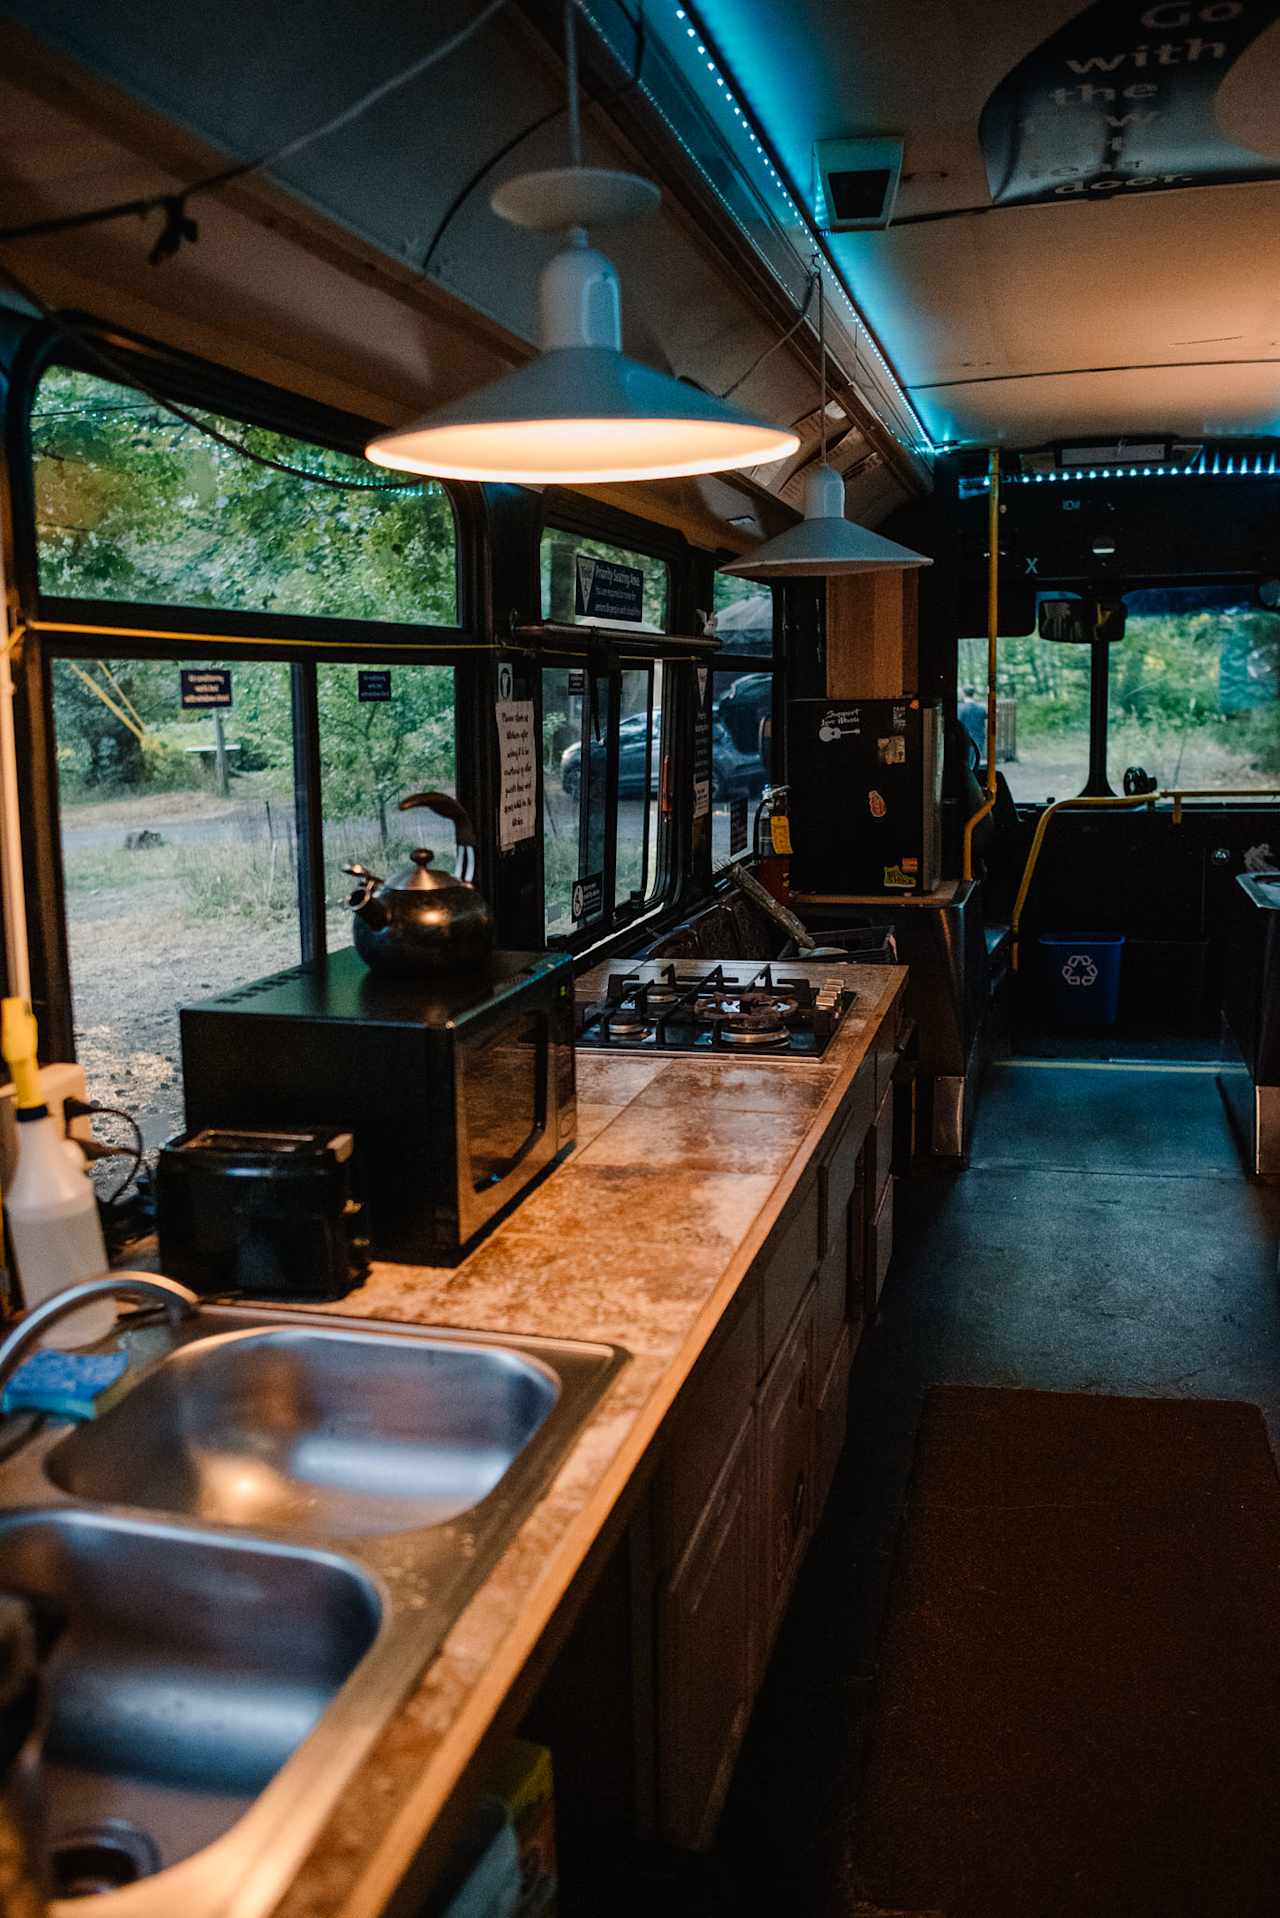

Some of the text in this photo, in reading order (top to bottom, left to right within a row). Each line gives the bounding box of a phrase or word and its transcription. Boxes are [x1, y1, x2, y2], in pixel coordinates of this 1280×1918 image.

[1139, 0, 1243, 30] Go
[1065, 37, 1226, 75] with
[1049, 81, 1160, 106] the
